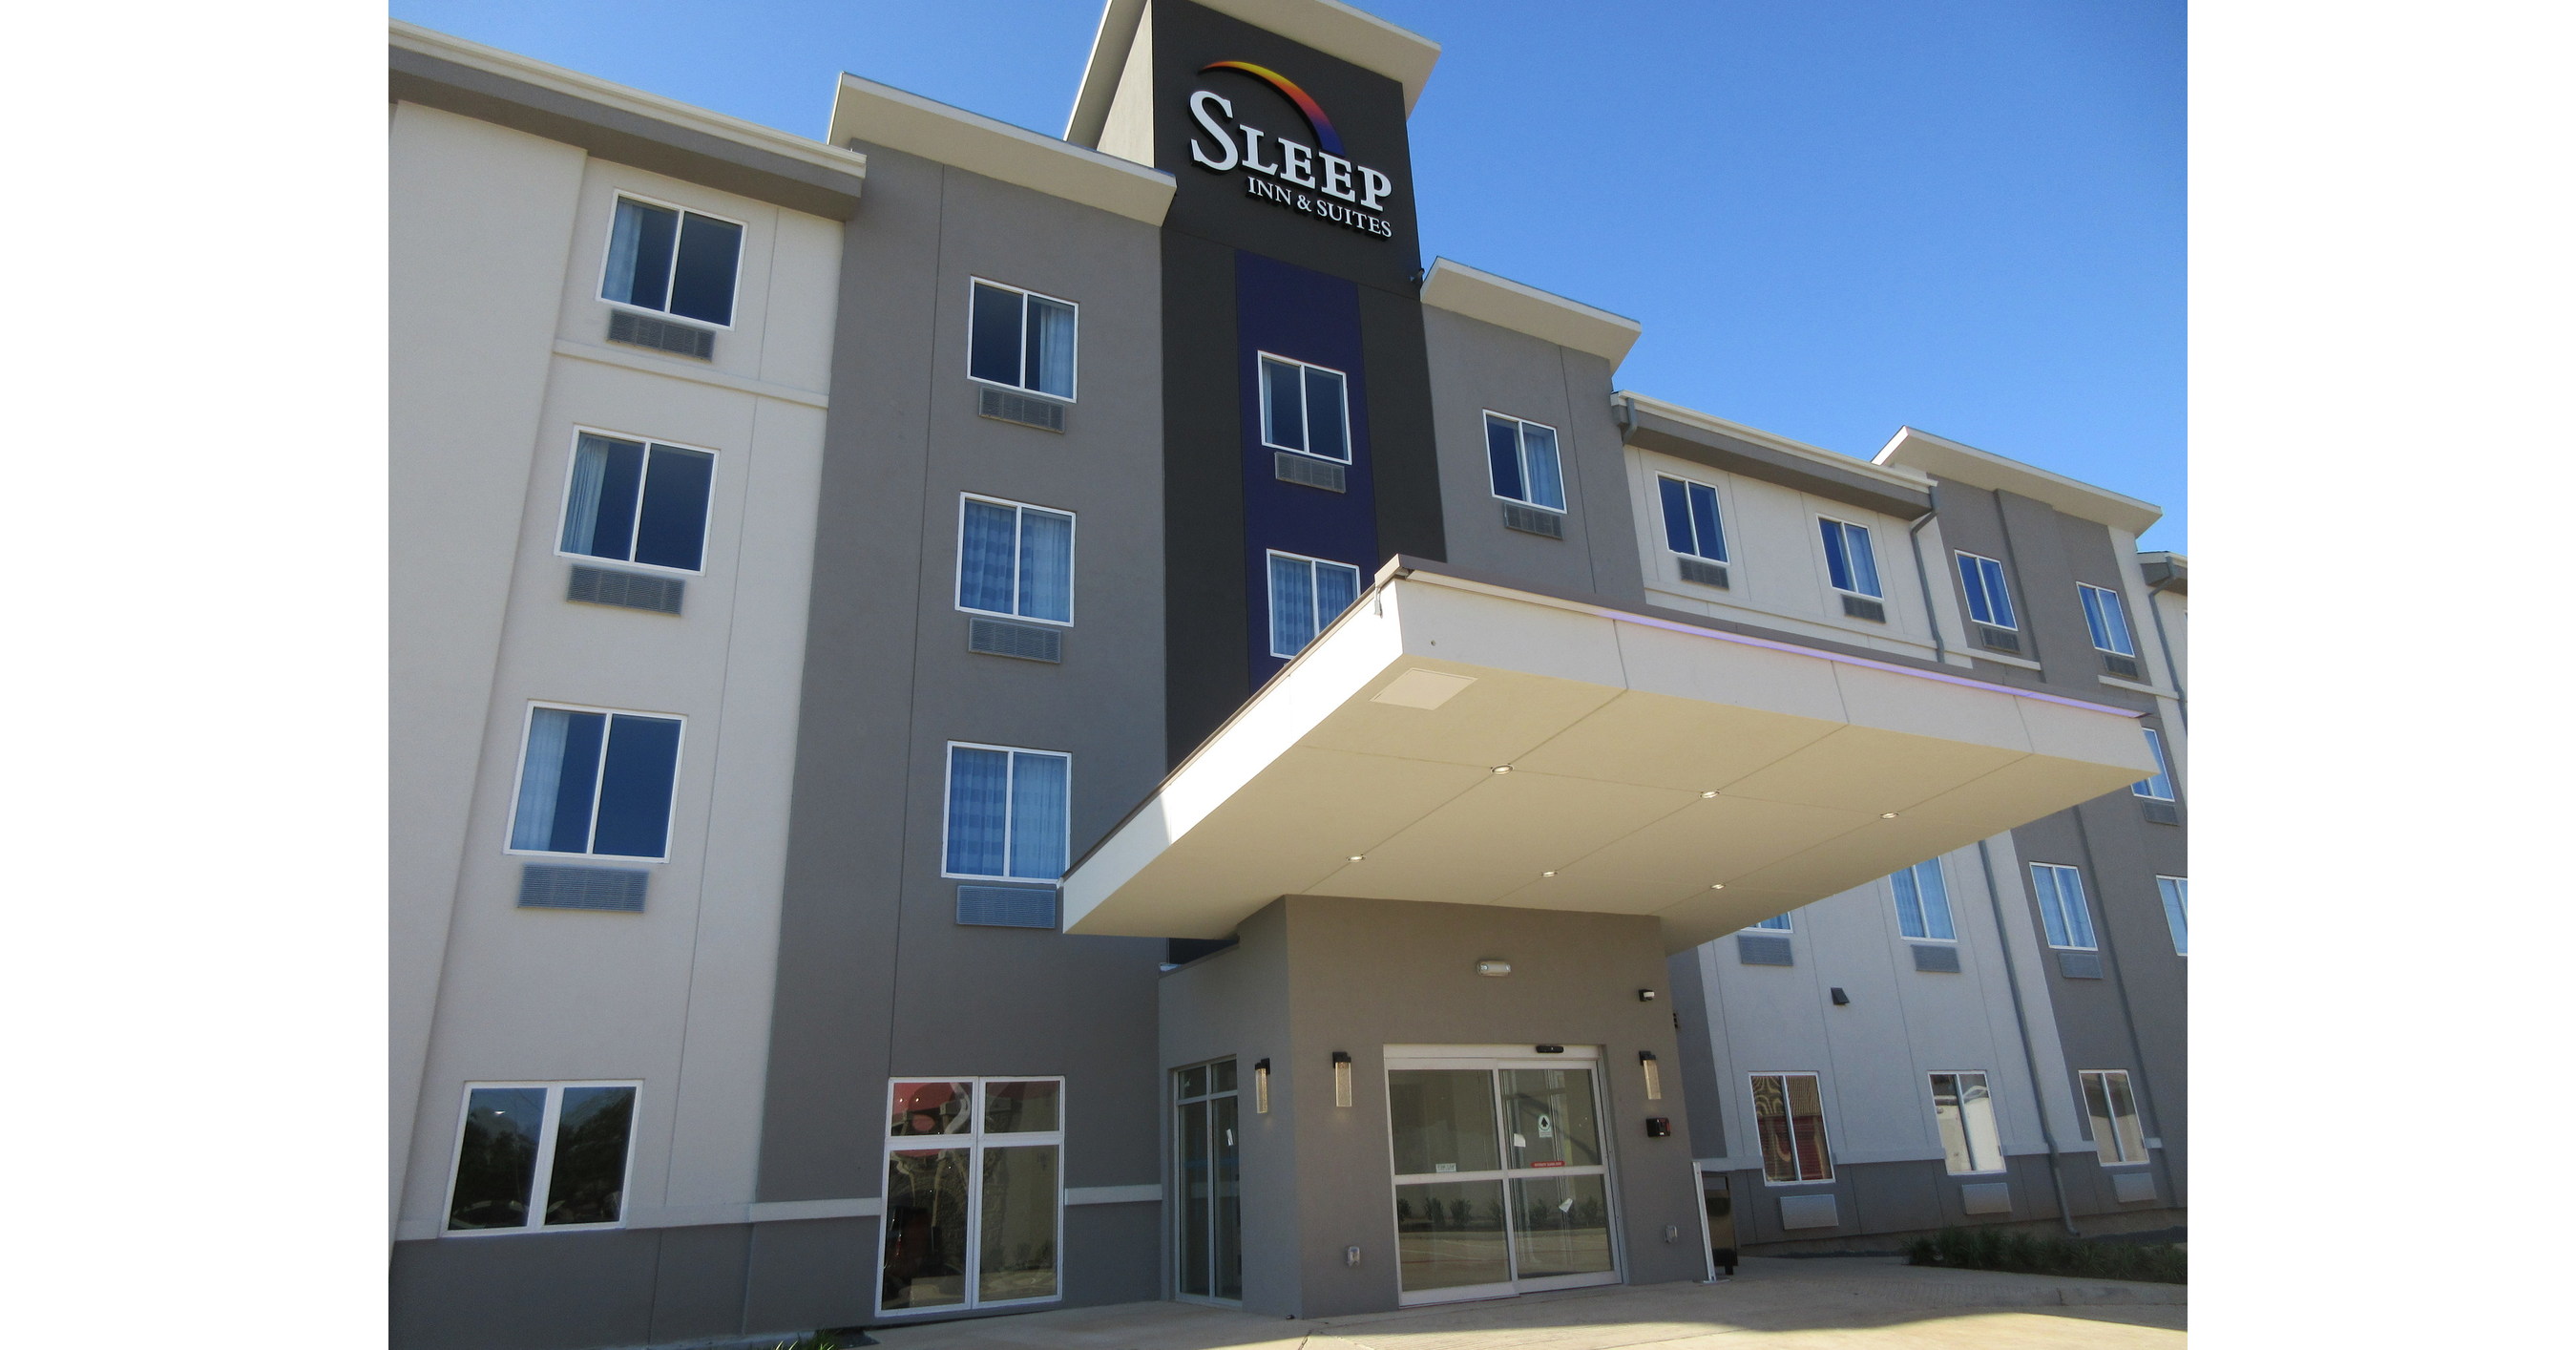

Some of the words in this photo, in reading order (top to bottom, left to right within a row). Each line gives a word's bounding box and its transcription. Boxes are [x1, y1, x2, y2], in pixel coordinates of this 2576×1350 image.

[1189, 90, 1393, 212] SLEEP
[1247, 176, 1292, 205] INN
[1296, 194, 1312, 212] &
[1316, 200, 1393, 238] SUITES
